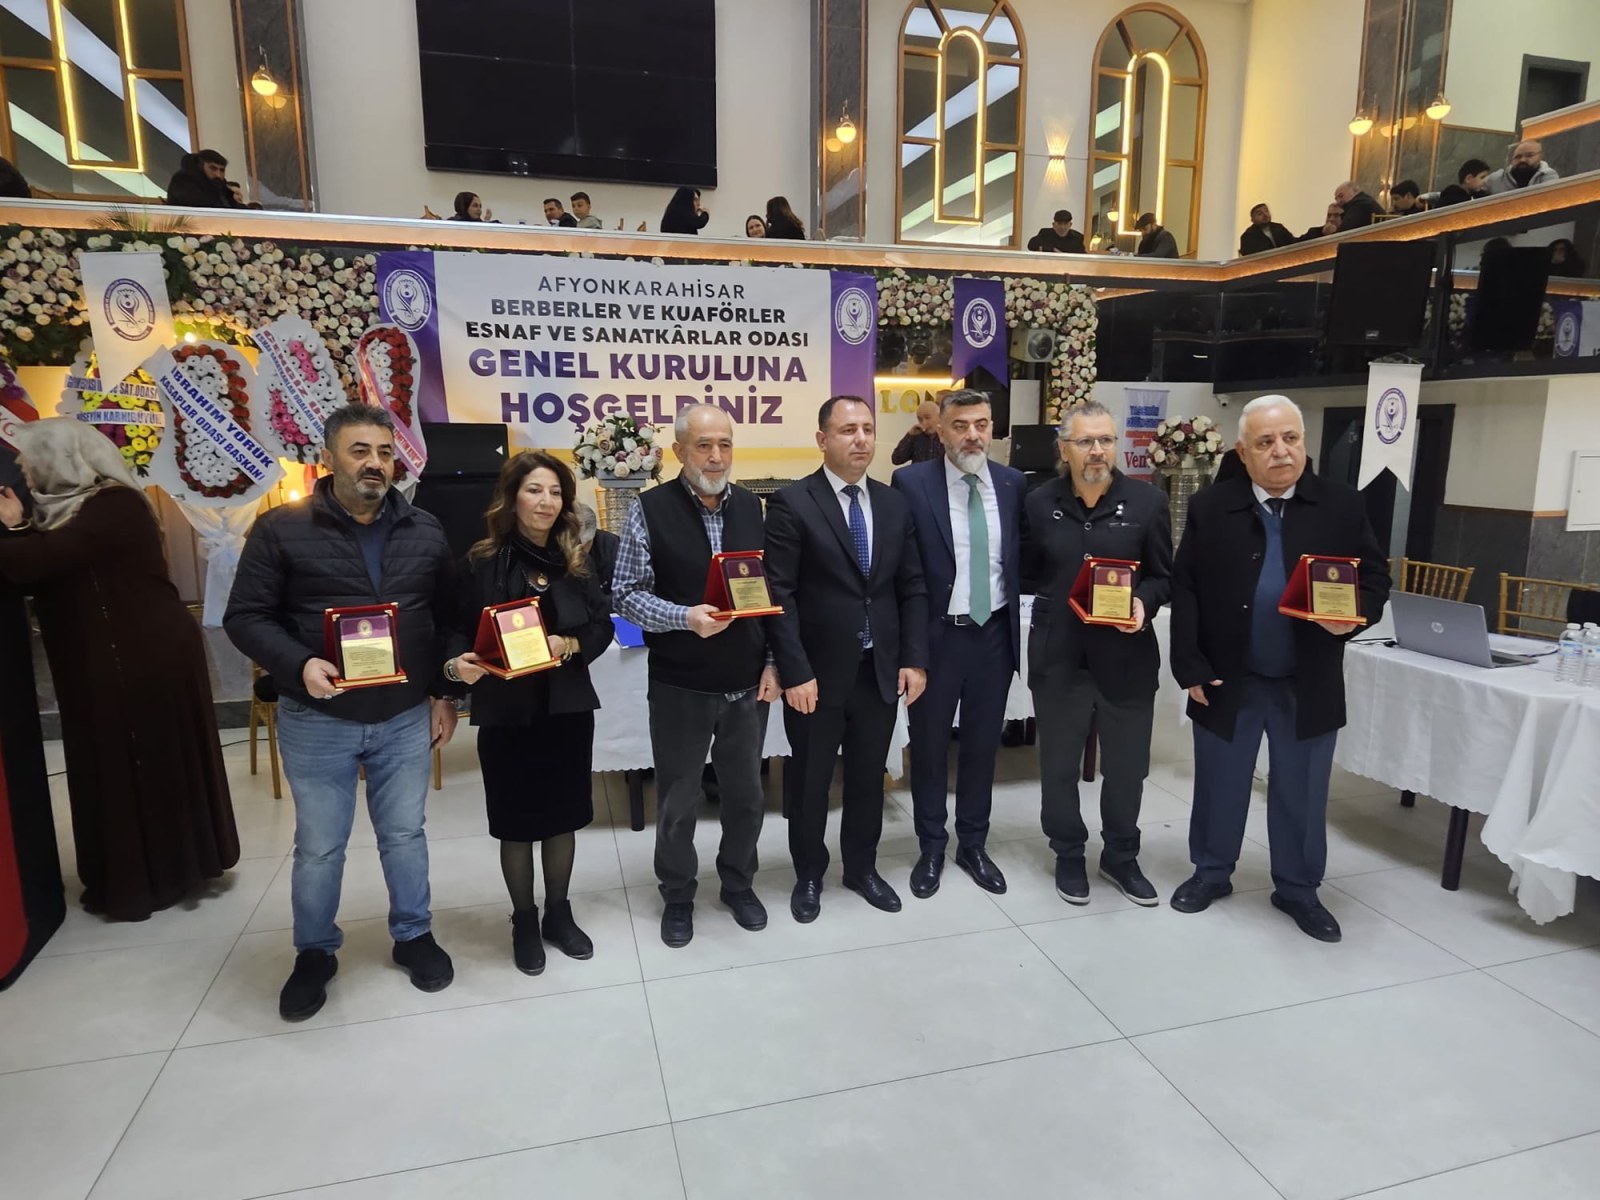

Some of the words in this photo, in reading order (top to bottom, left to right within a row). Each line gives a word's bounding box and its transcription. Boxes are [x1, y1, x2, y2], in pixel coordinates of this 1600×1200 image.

[538, 274, 745, 300] AFYONKARAHİSAR
[491, 298, 621, 320] BERBERLER
[627, 303, 656, 321] VE
[661, 300, 786, 324] KUAFÖRLER
[465, 321, 542, 342] ESNAF
[546, 325, 577, 343] VE
[581, 323, 743, 347] SANATKÂRLAR
[747, 330, 809, 348] ODASI
[468, 348, 600, 380] GENEL
[609, 352, 808, 383] KURULUNA
[159, 375, 198, 419] KASAPLAR
[195, 416, 227, 446] ODASI
[226, 422, 275, 470] YÖRÜK
[1124, 451, 1151, 468] Ven
